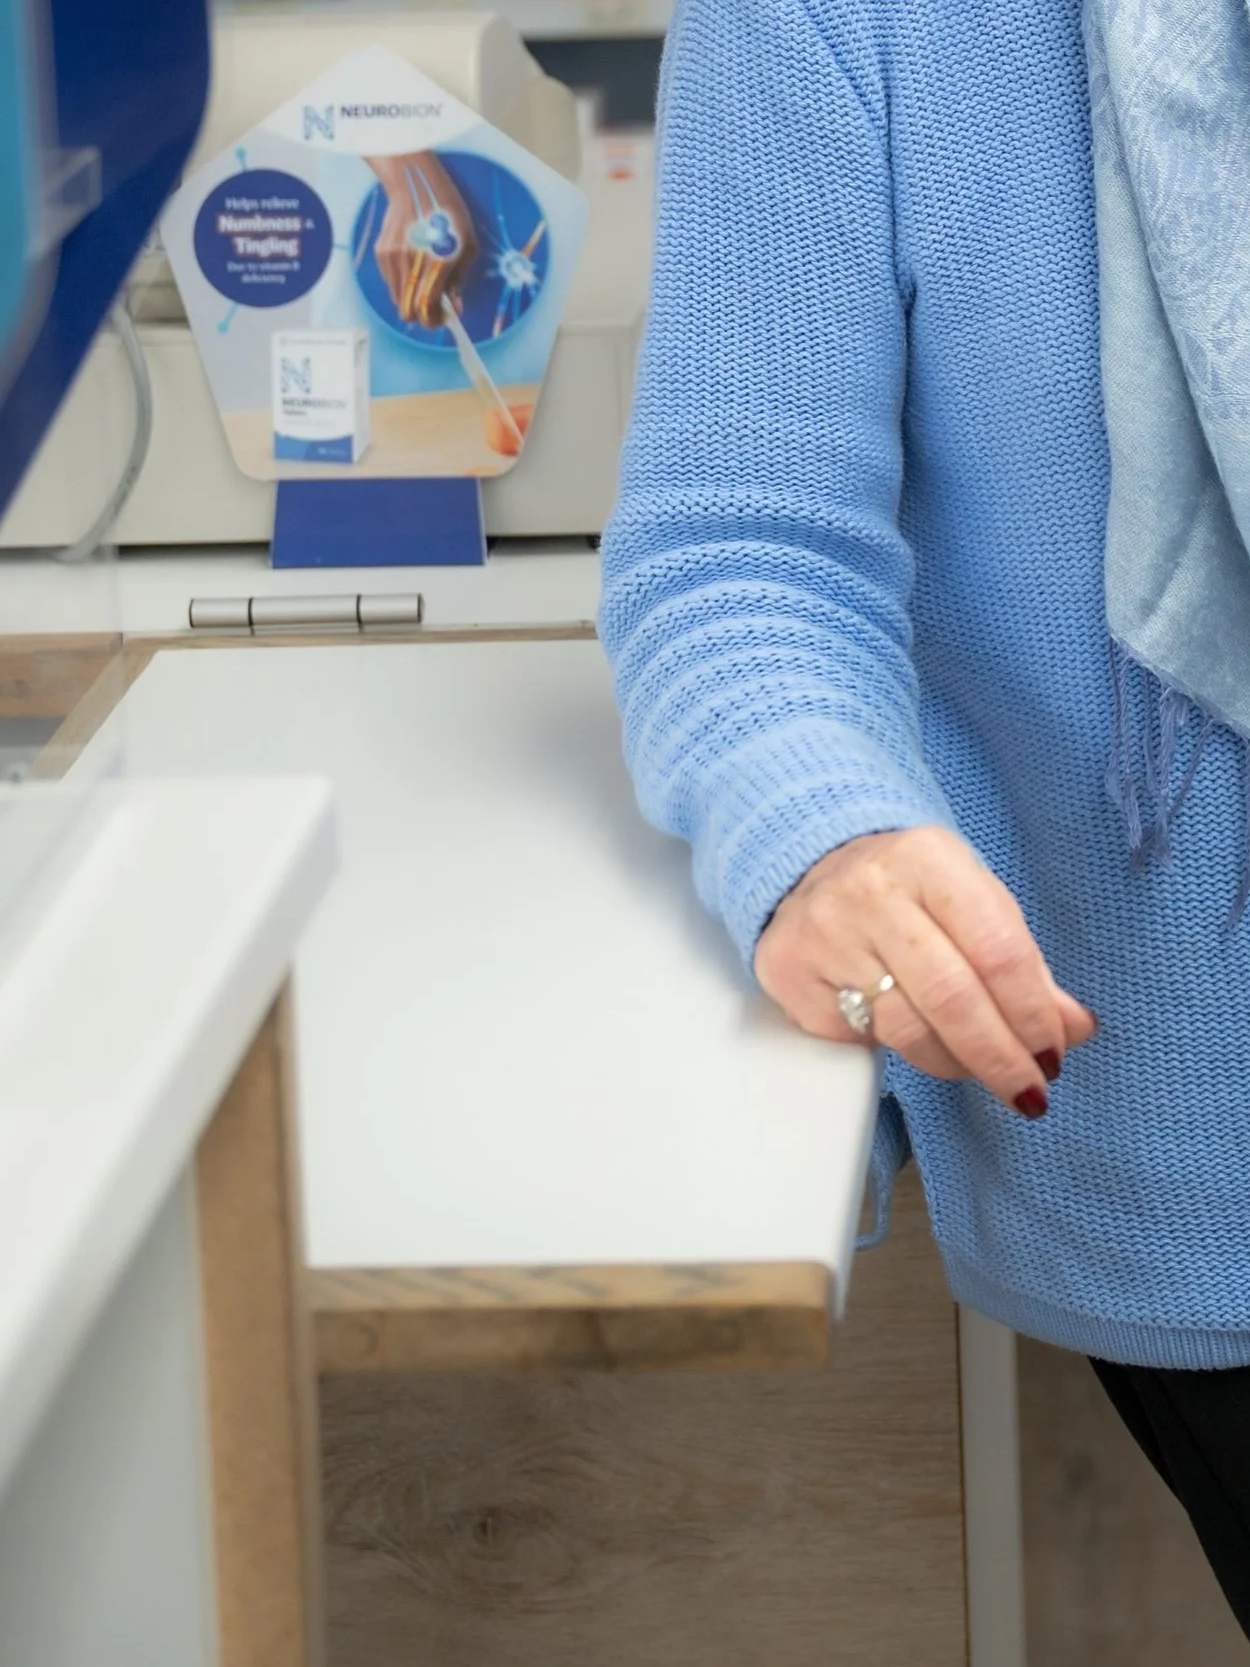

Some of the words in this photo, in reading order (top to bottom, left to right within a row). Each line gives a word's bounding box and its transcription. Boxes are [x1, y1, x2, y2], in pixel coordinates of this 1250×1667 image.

[224, 196, 259, 212] Helps
[218, 214, 301, 233] Numbness
[234, 236, 299, 257] Tingling
